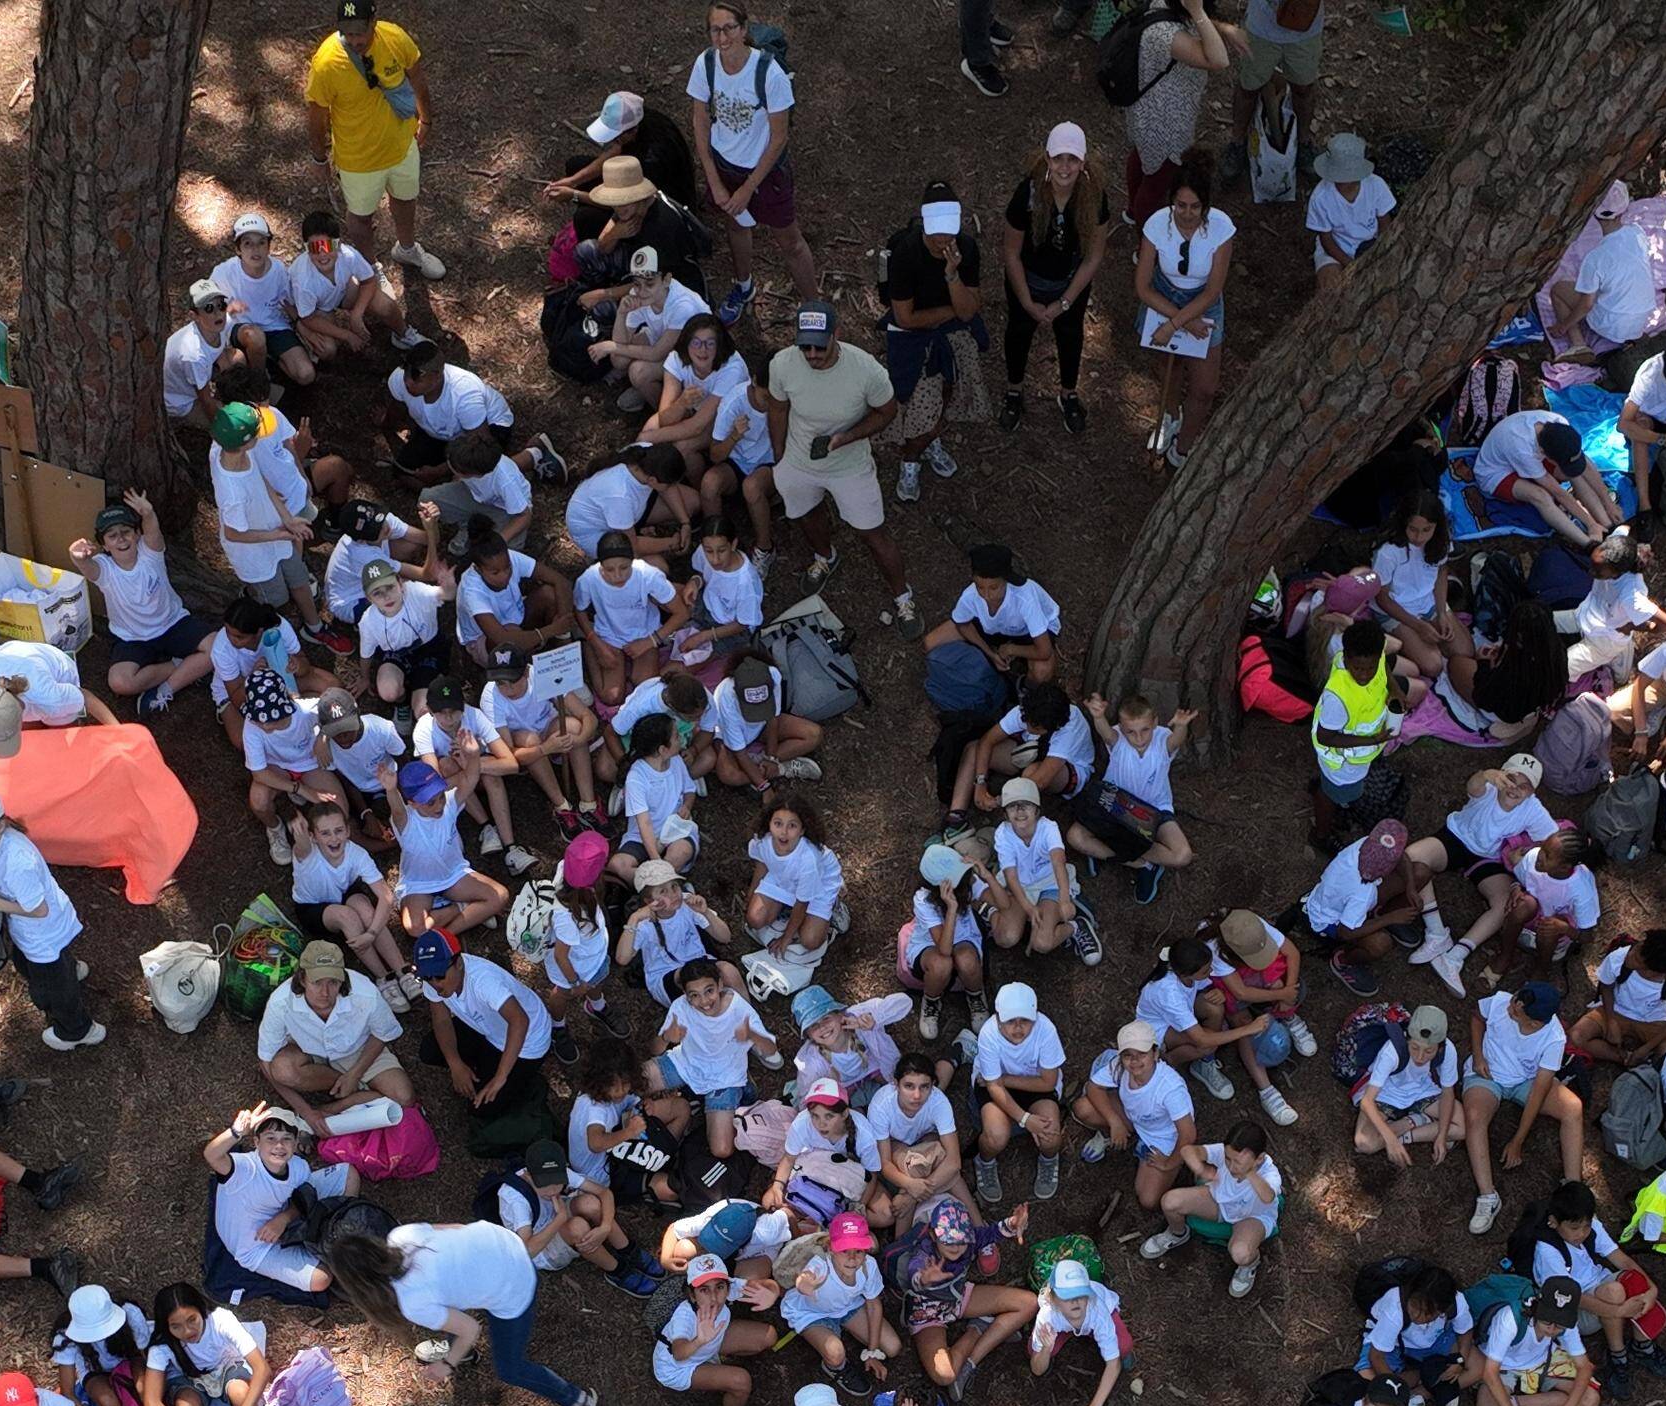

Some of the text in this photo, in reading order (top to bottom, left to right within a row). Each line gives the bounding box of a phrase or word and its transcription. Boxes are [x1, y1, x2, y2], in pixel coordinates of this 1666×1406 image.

[368, 564, 381, 579] NY
[331, 704, 344, 719] NY
[1521, 756, 1535, 769] M
[5, 1386, 20, 1403] NY
